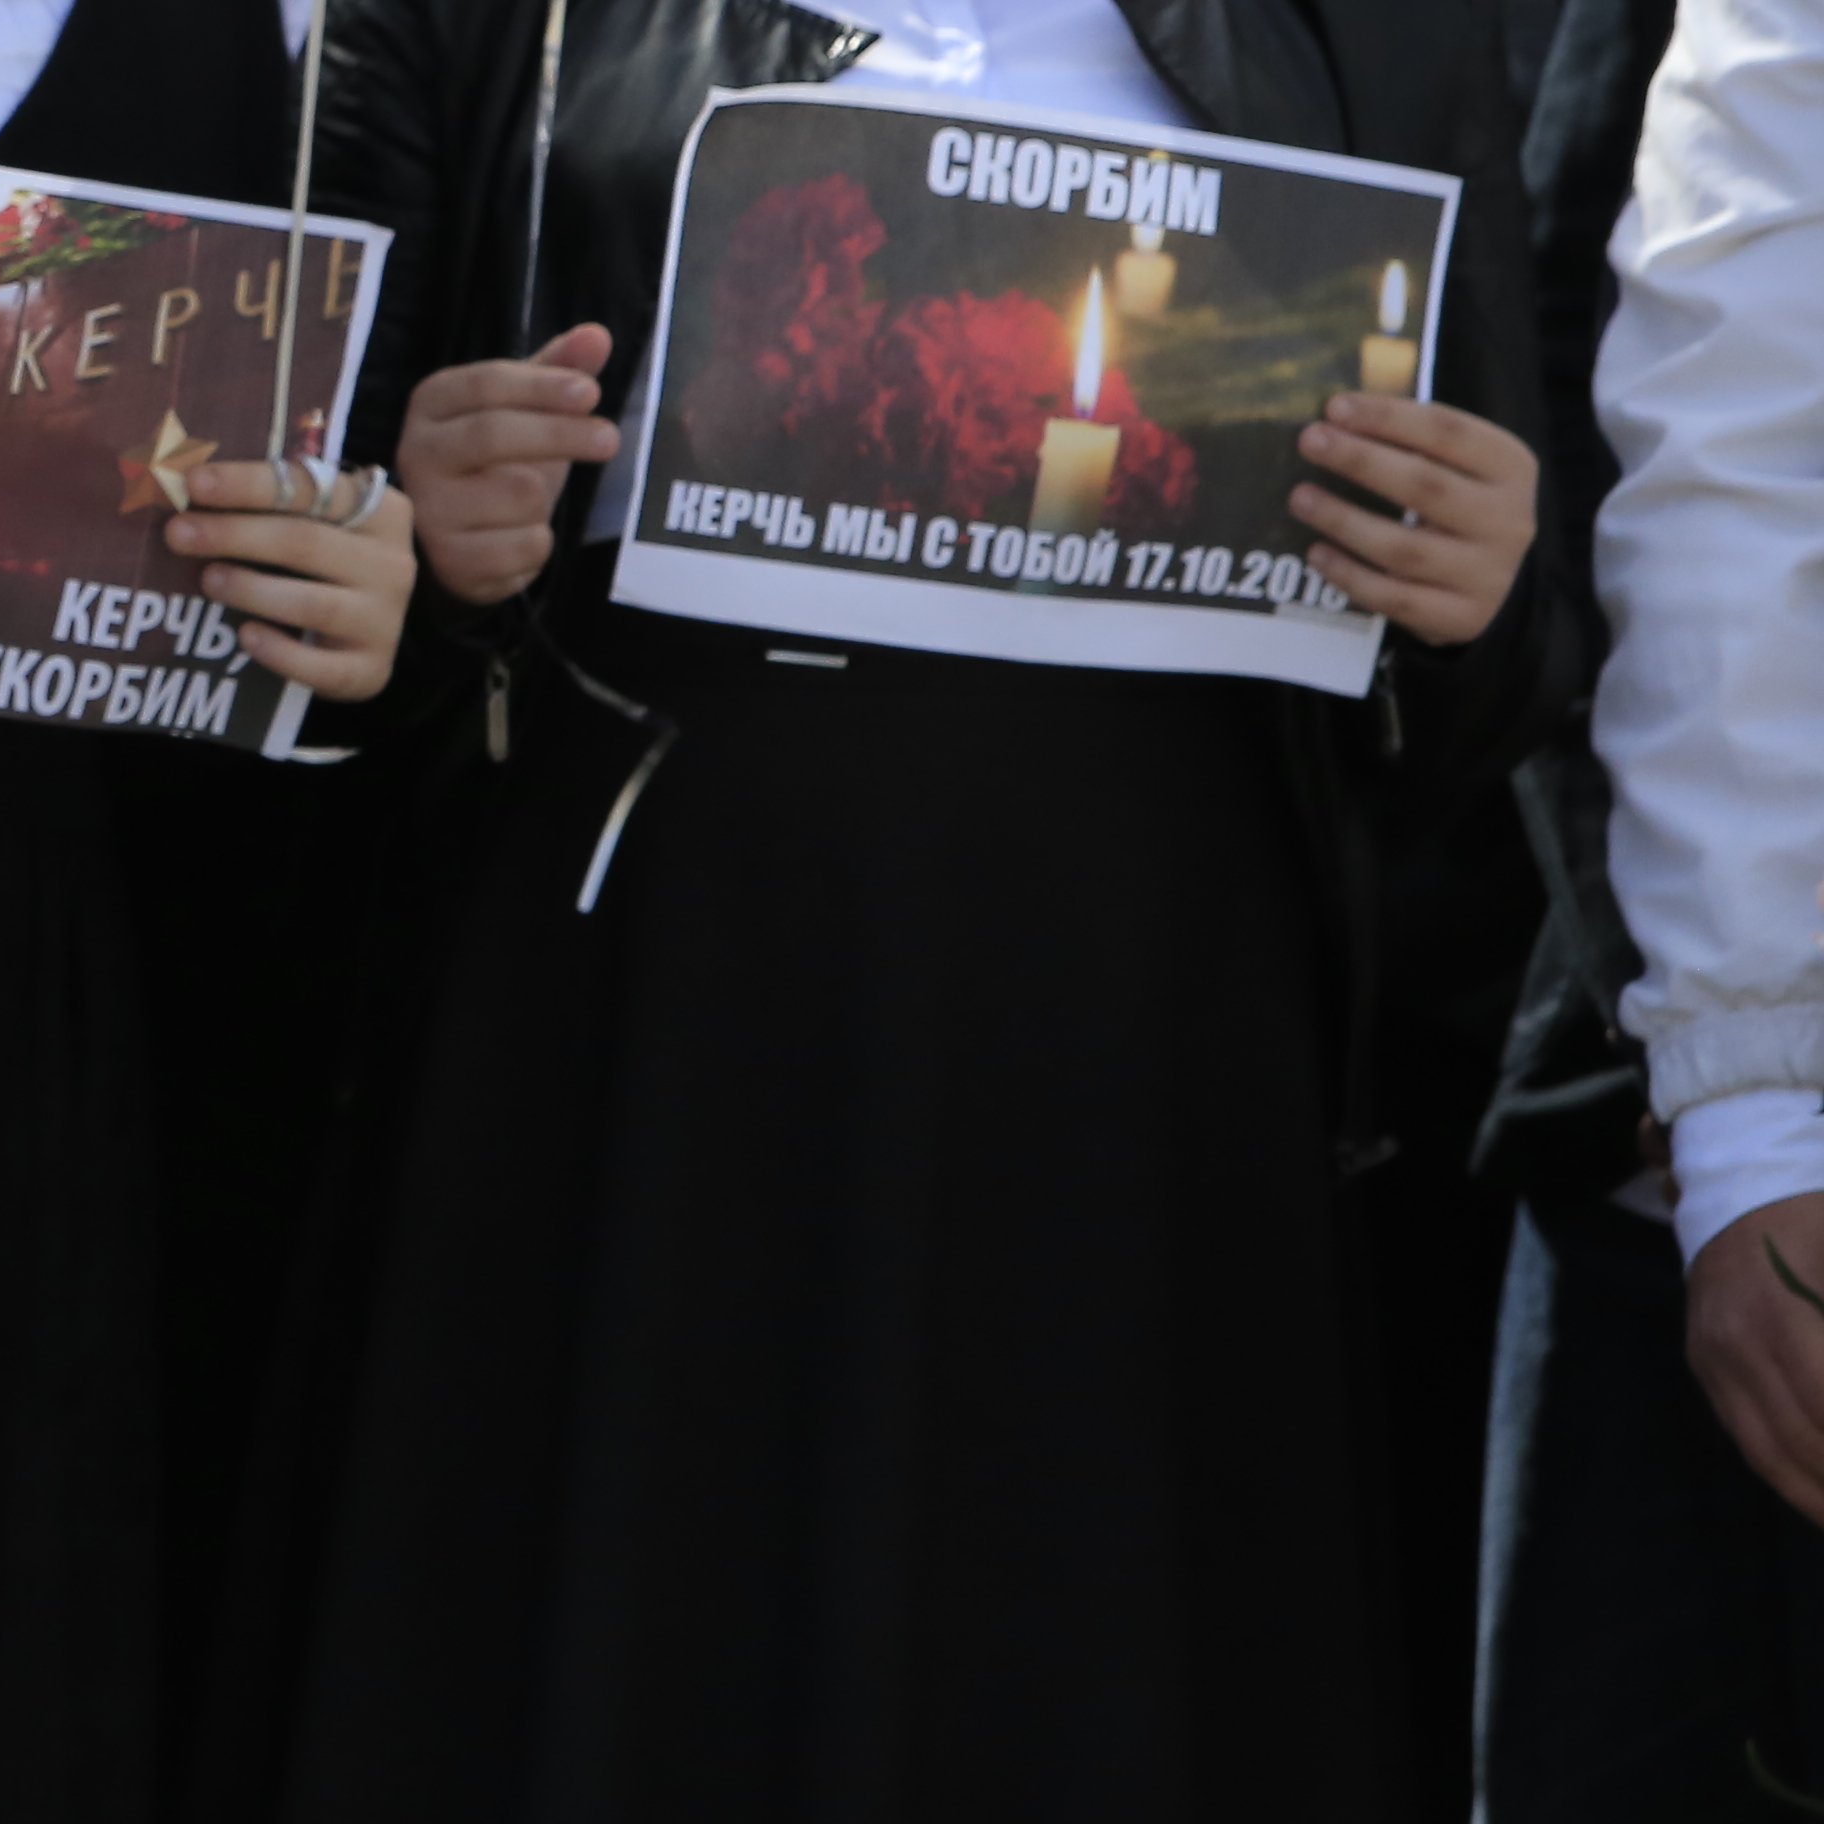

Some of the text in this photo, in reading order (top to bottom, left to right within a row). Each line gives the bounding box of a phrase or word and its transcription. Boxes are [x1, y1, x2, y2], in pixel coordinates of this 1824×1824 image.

[927, 127, 1222, 237] СКОРБИМ
[664, 480, 815, 550] КЕРЧЬ
[821, 500, 915, 564] МЫ
[921, 513, 959, 569] С
[967, 520, 1120, 587] ТОБОЙ
[52, 578, 252, 674] КЕРЧЬ,
